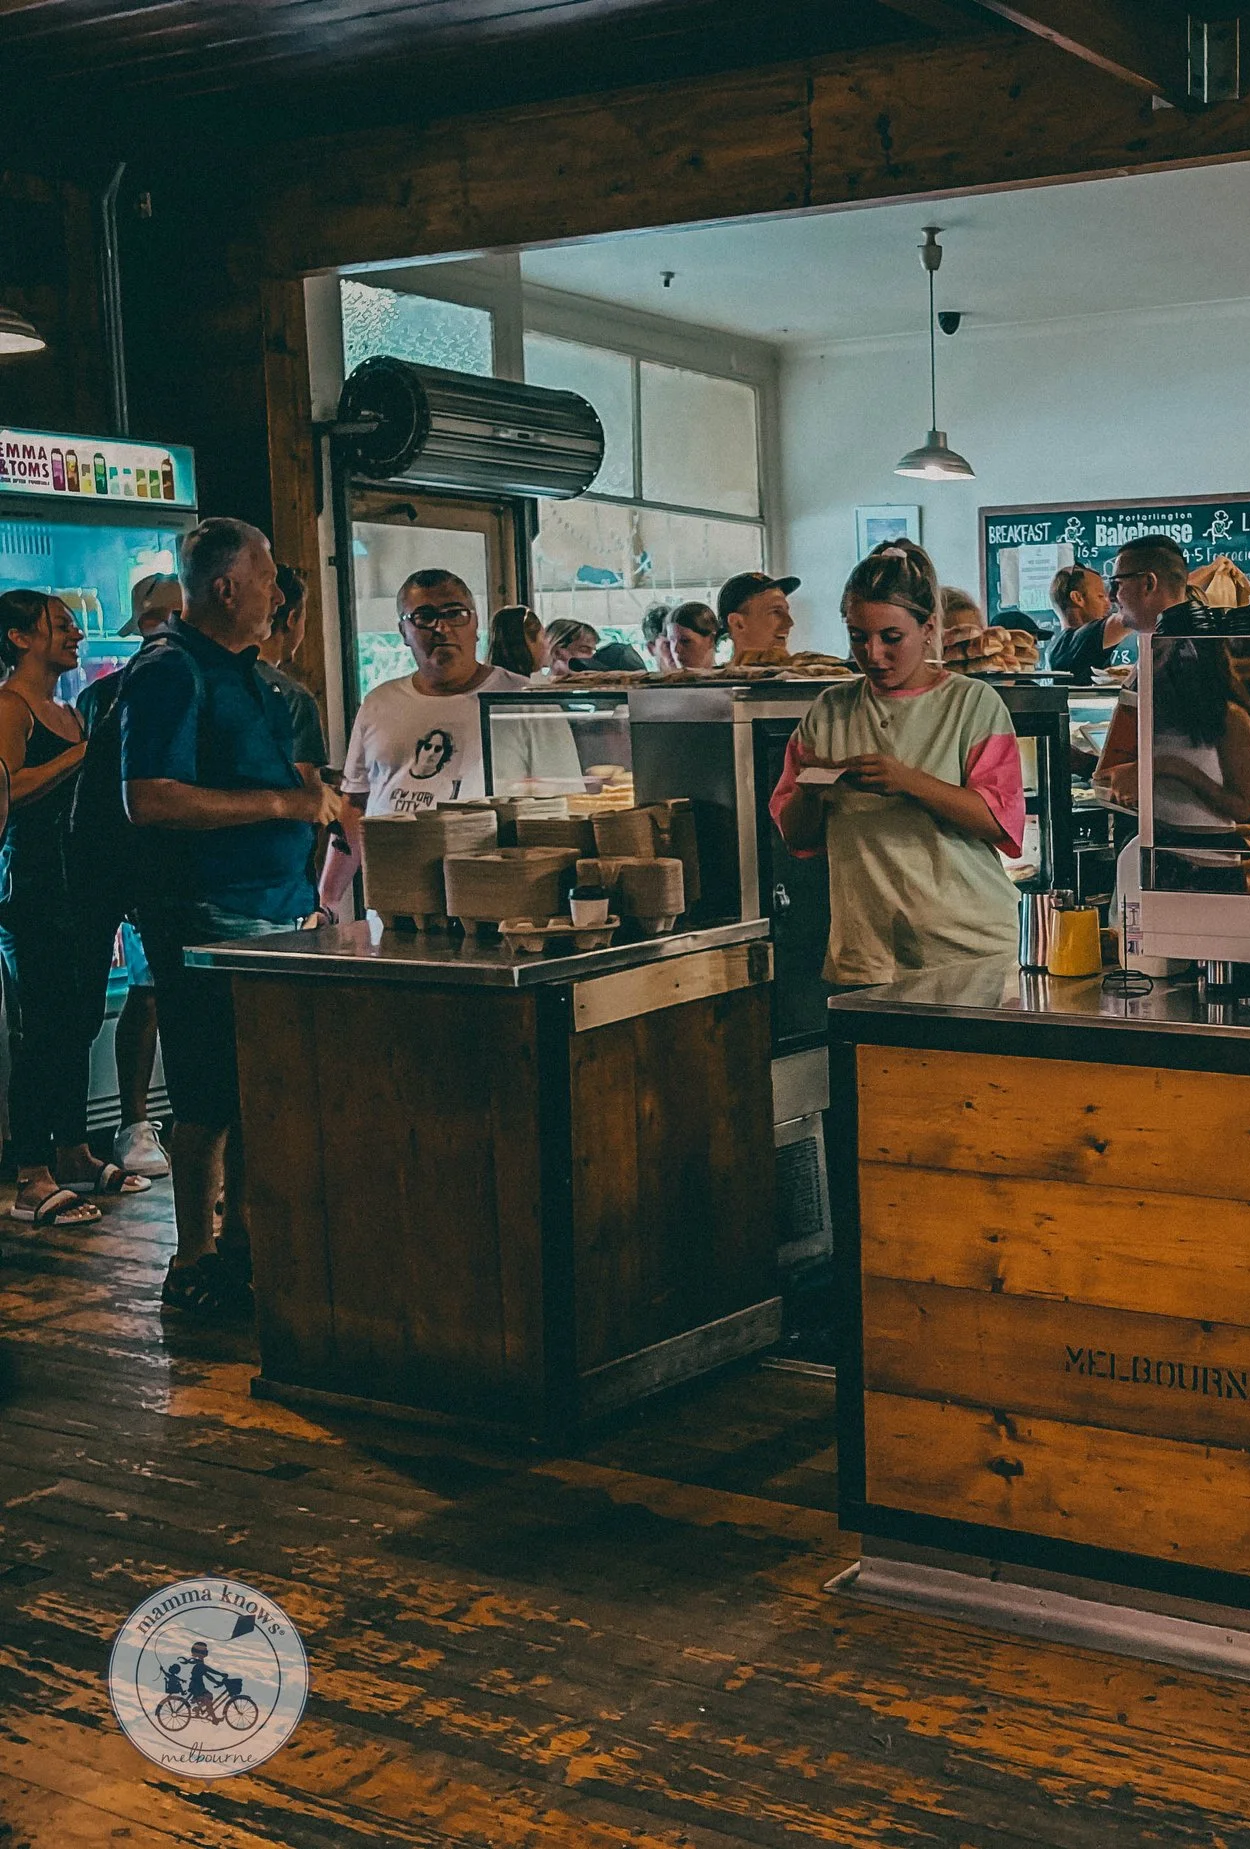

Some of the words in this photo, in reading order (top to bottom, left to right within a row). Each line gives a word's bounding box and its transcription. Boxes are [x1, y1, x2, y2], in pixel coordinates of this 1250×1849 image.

[1096, 515, 1114, 523] The
[1119, 512, 1193, 522] Portarlington
[988, 522, 1052, 544] BREAKFAST
[1095, 522, 1193, 547] Bakehouse
